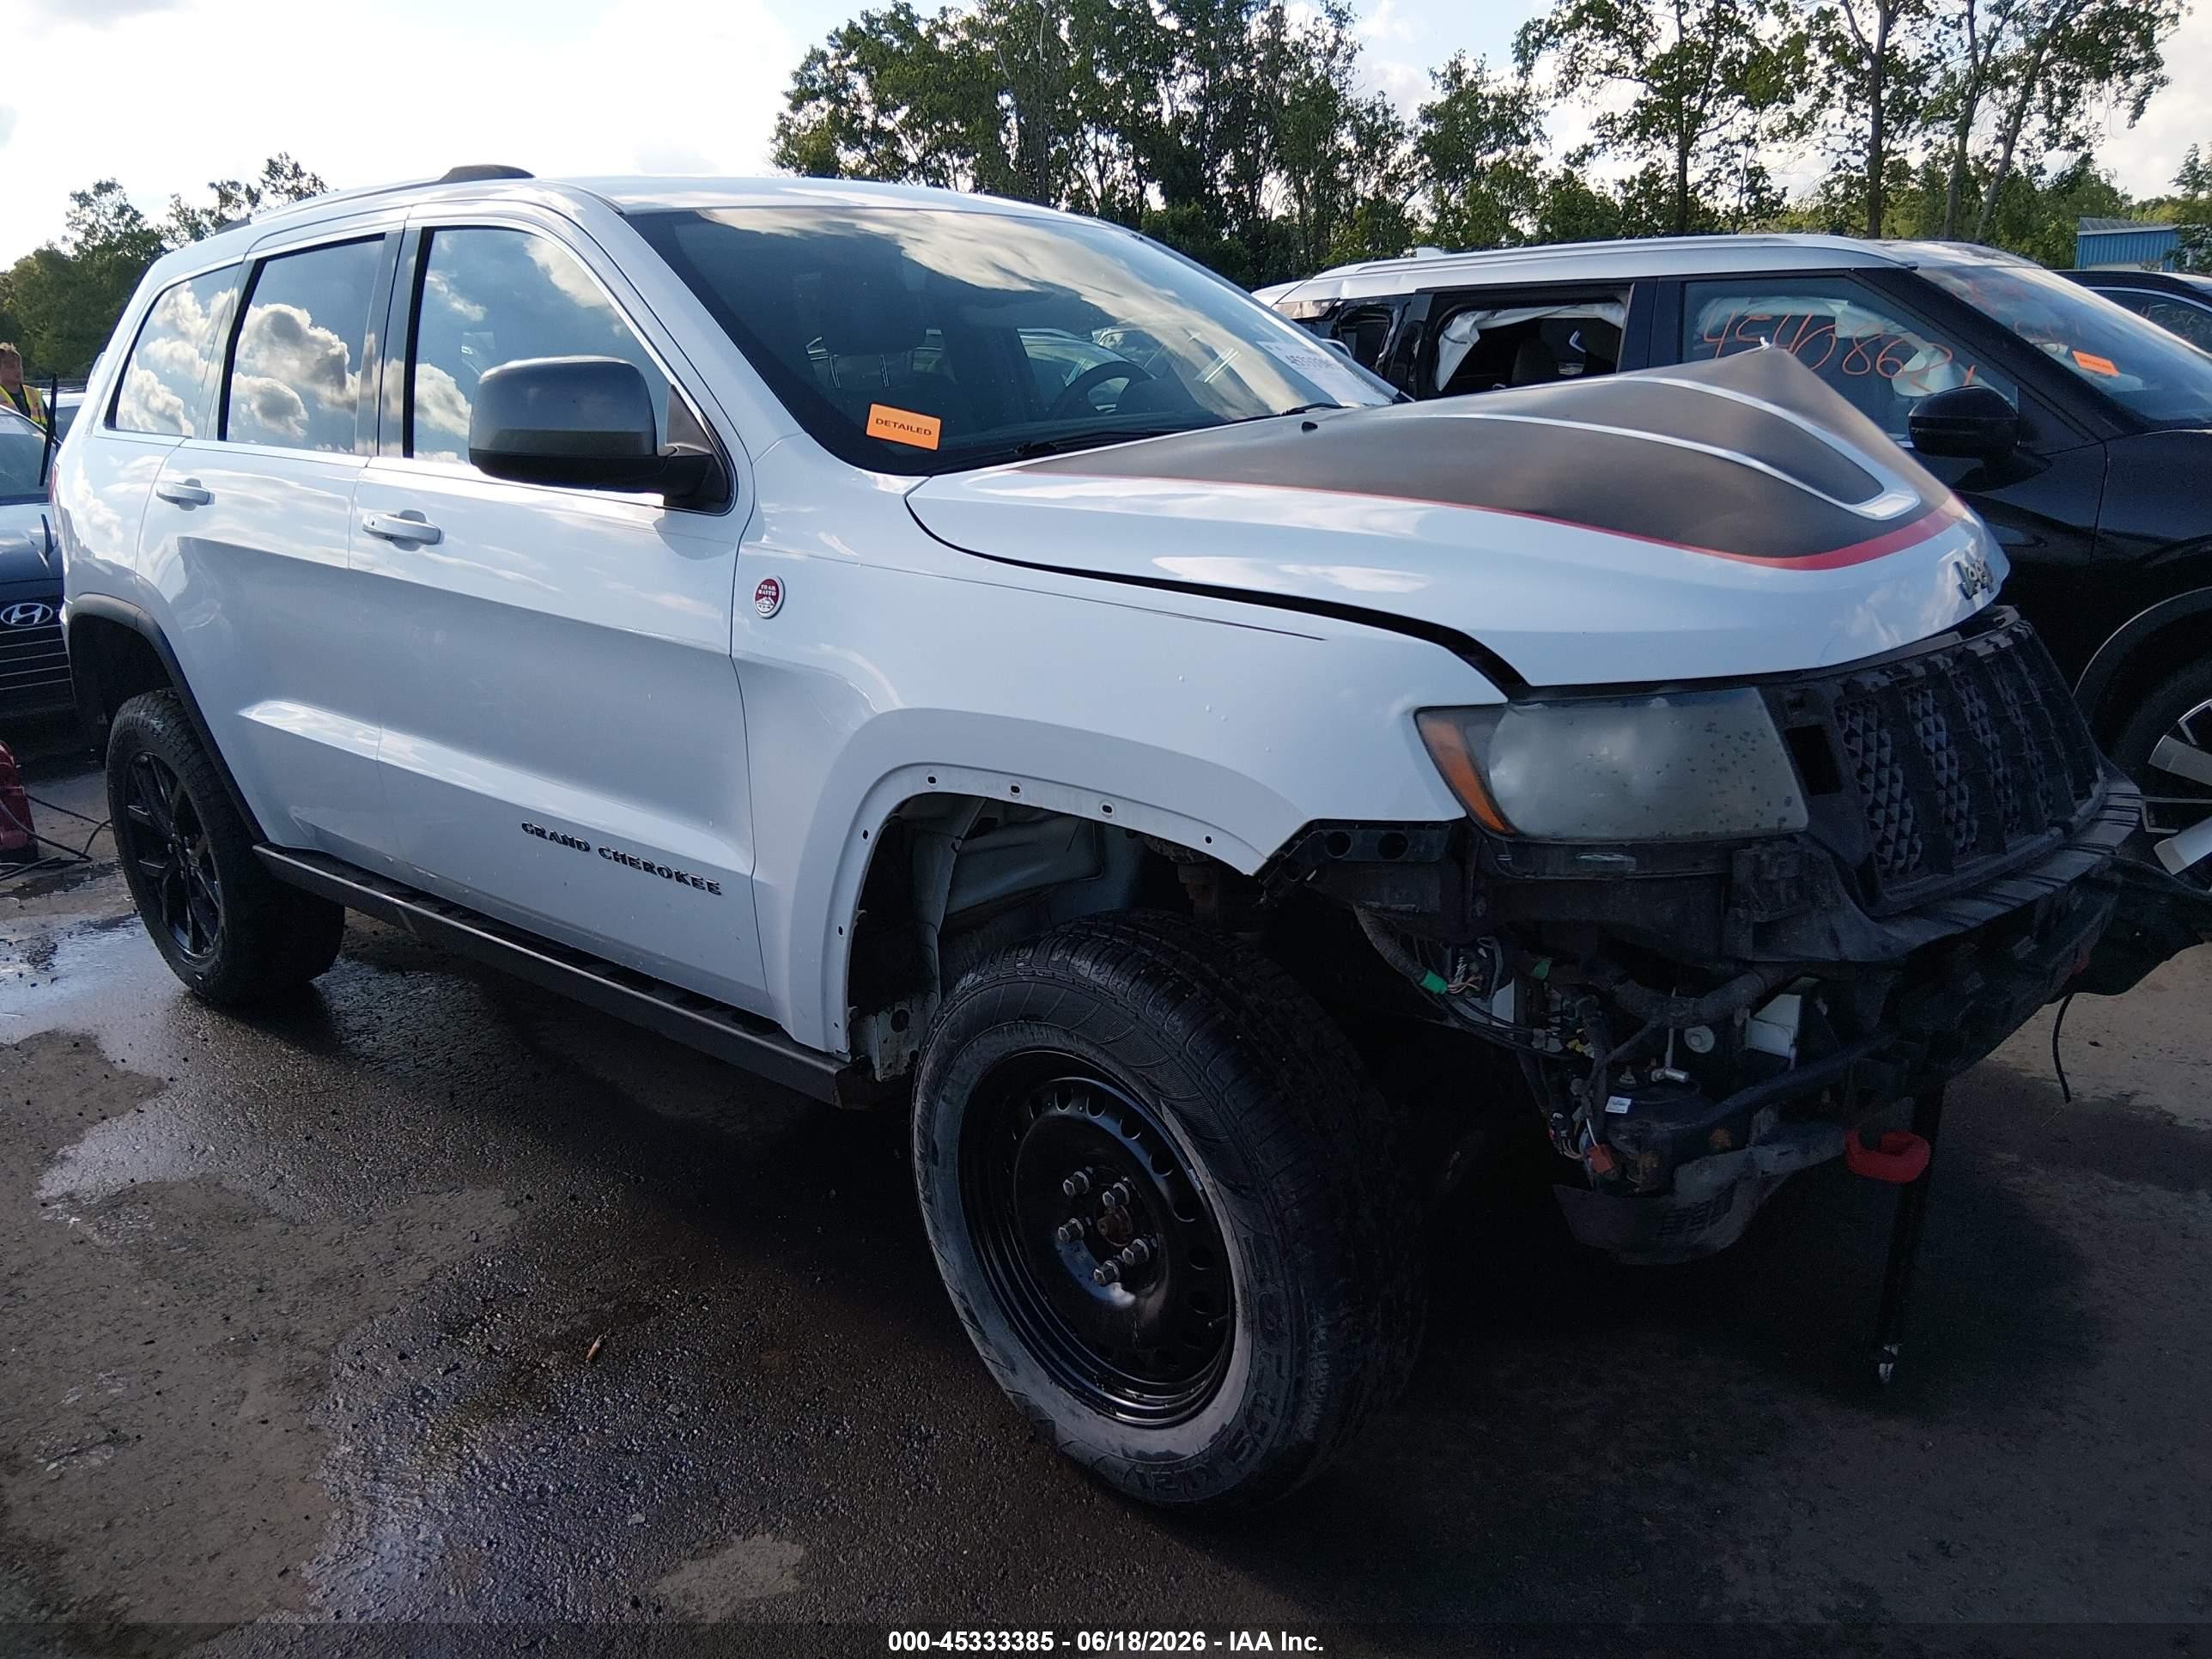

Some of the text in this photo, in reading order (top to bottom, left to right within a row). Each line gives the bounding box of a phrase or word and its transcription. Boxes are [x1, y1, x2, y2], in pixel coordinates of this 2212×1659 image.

[875, 417, 932, 436] DETAILED
[521, 821, 722, 896] GRAND CHEROKEE
